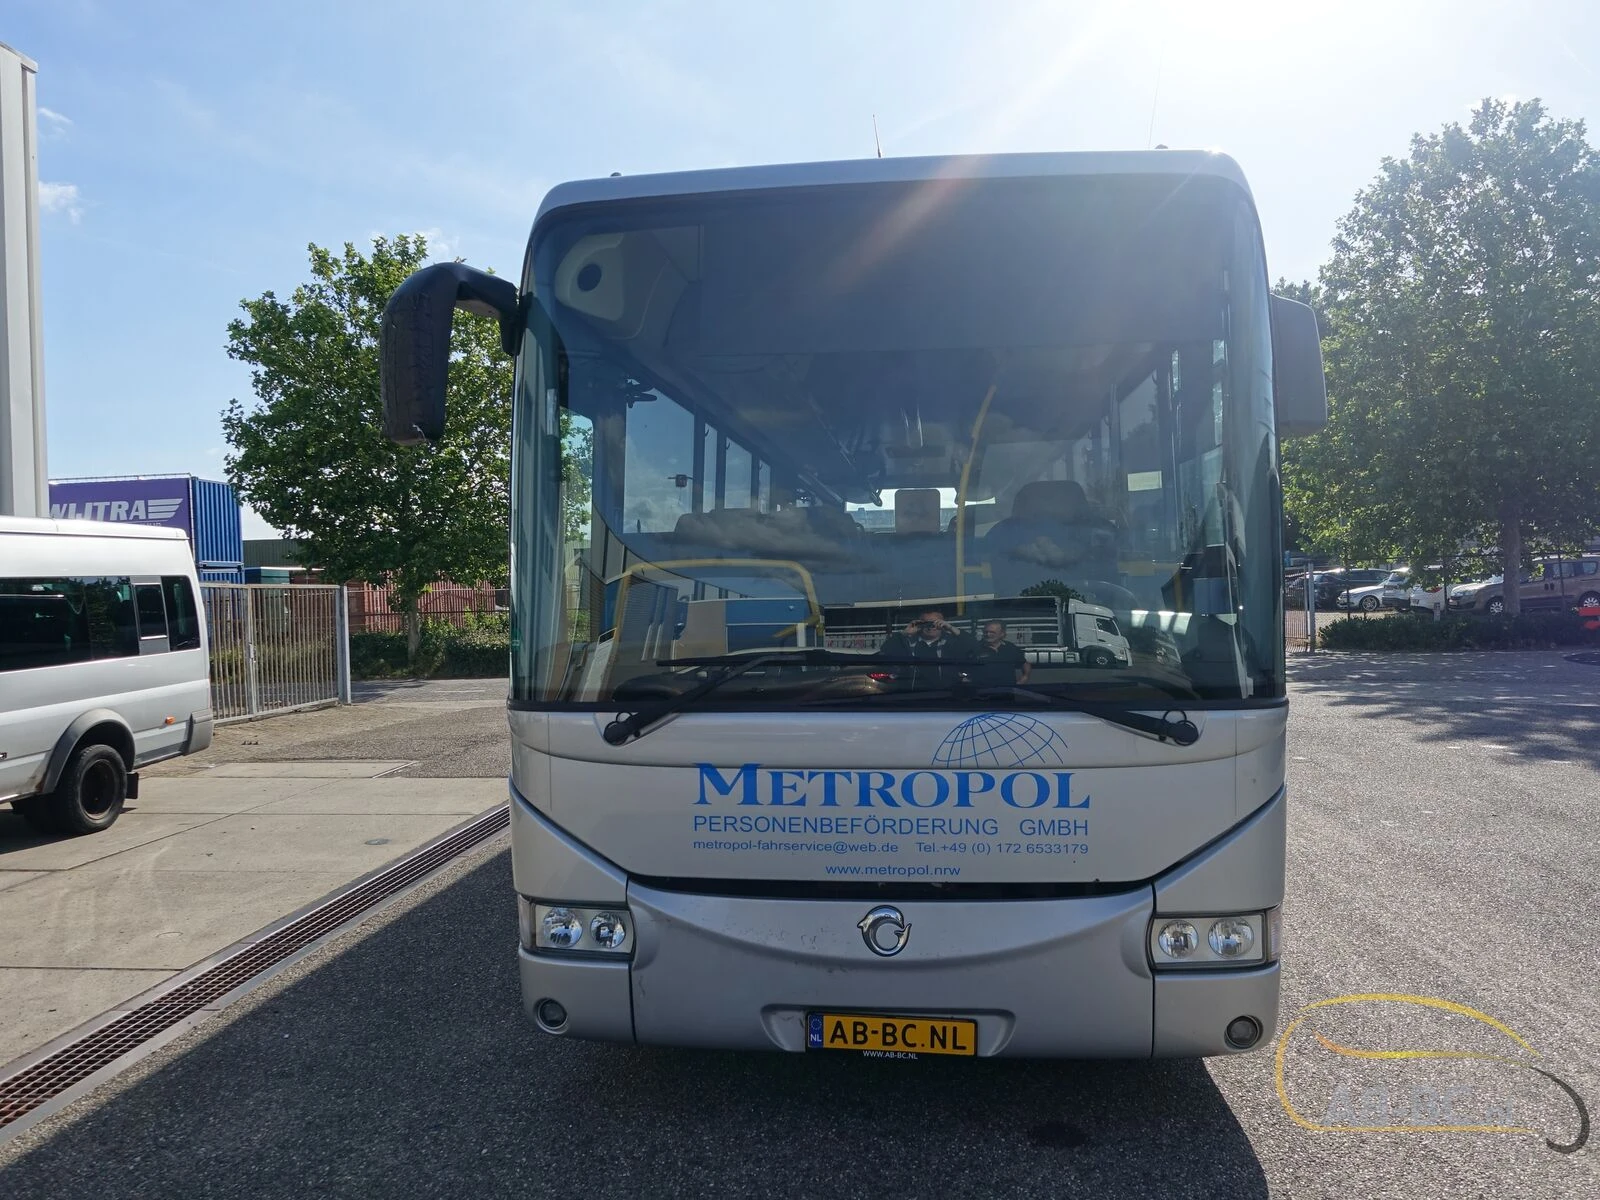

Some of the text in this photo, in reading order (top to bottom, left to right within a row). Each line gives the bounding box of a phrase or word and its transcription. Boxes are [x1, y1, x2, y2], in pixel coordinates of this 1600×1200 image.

[693, 816, 1089, 836] PERSONENBEFÖRDERUNG GMBH
[693, 840, 1089, 855] metropol-fahrservice@web.de Tel.+49 (0) 172 6533179
[826, 865, 961, 877] www.metropol.nrw
[810, 1034, 822, 1042] NL
[829, 1020, 967, 1051] AB-BC.NL
[863, 1050, 918, 1059] WWW.AB-BC.NL
